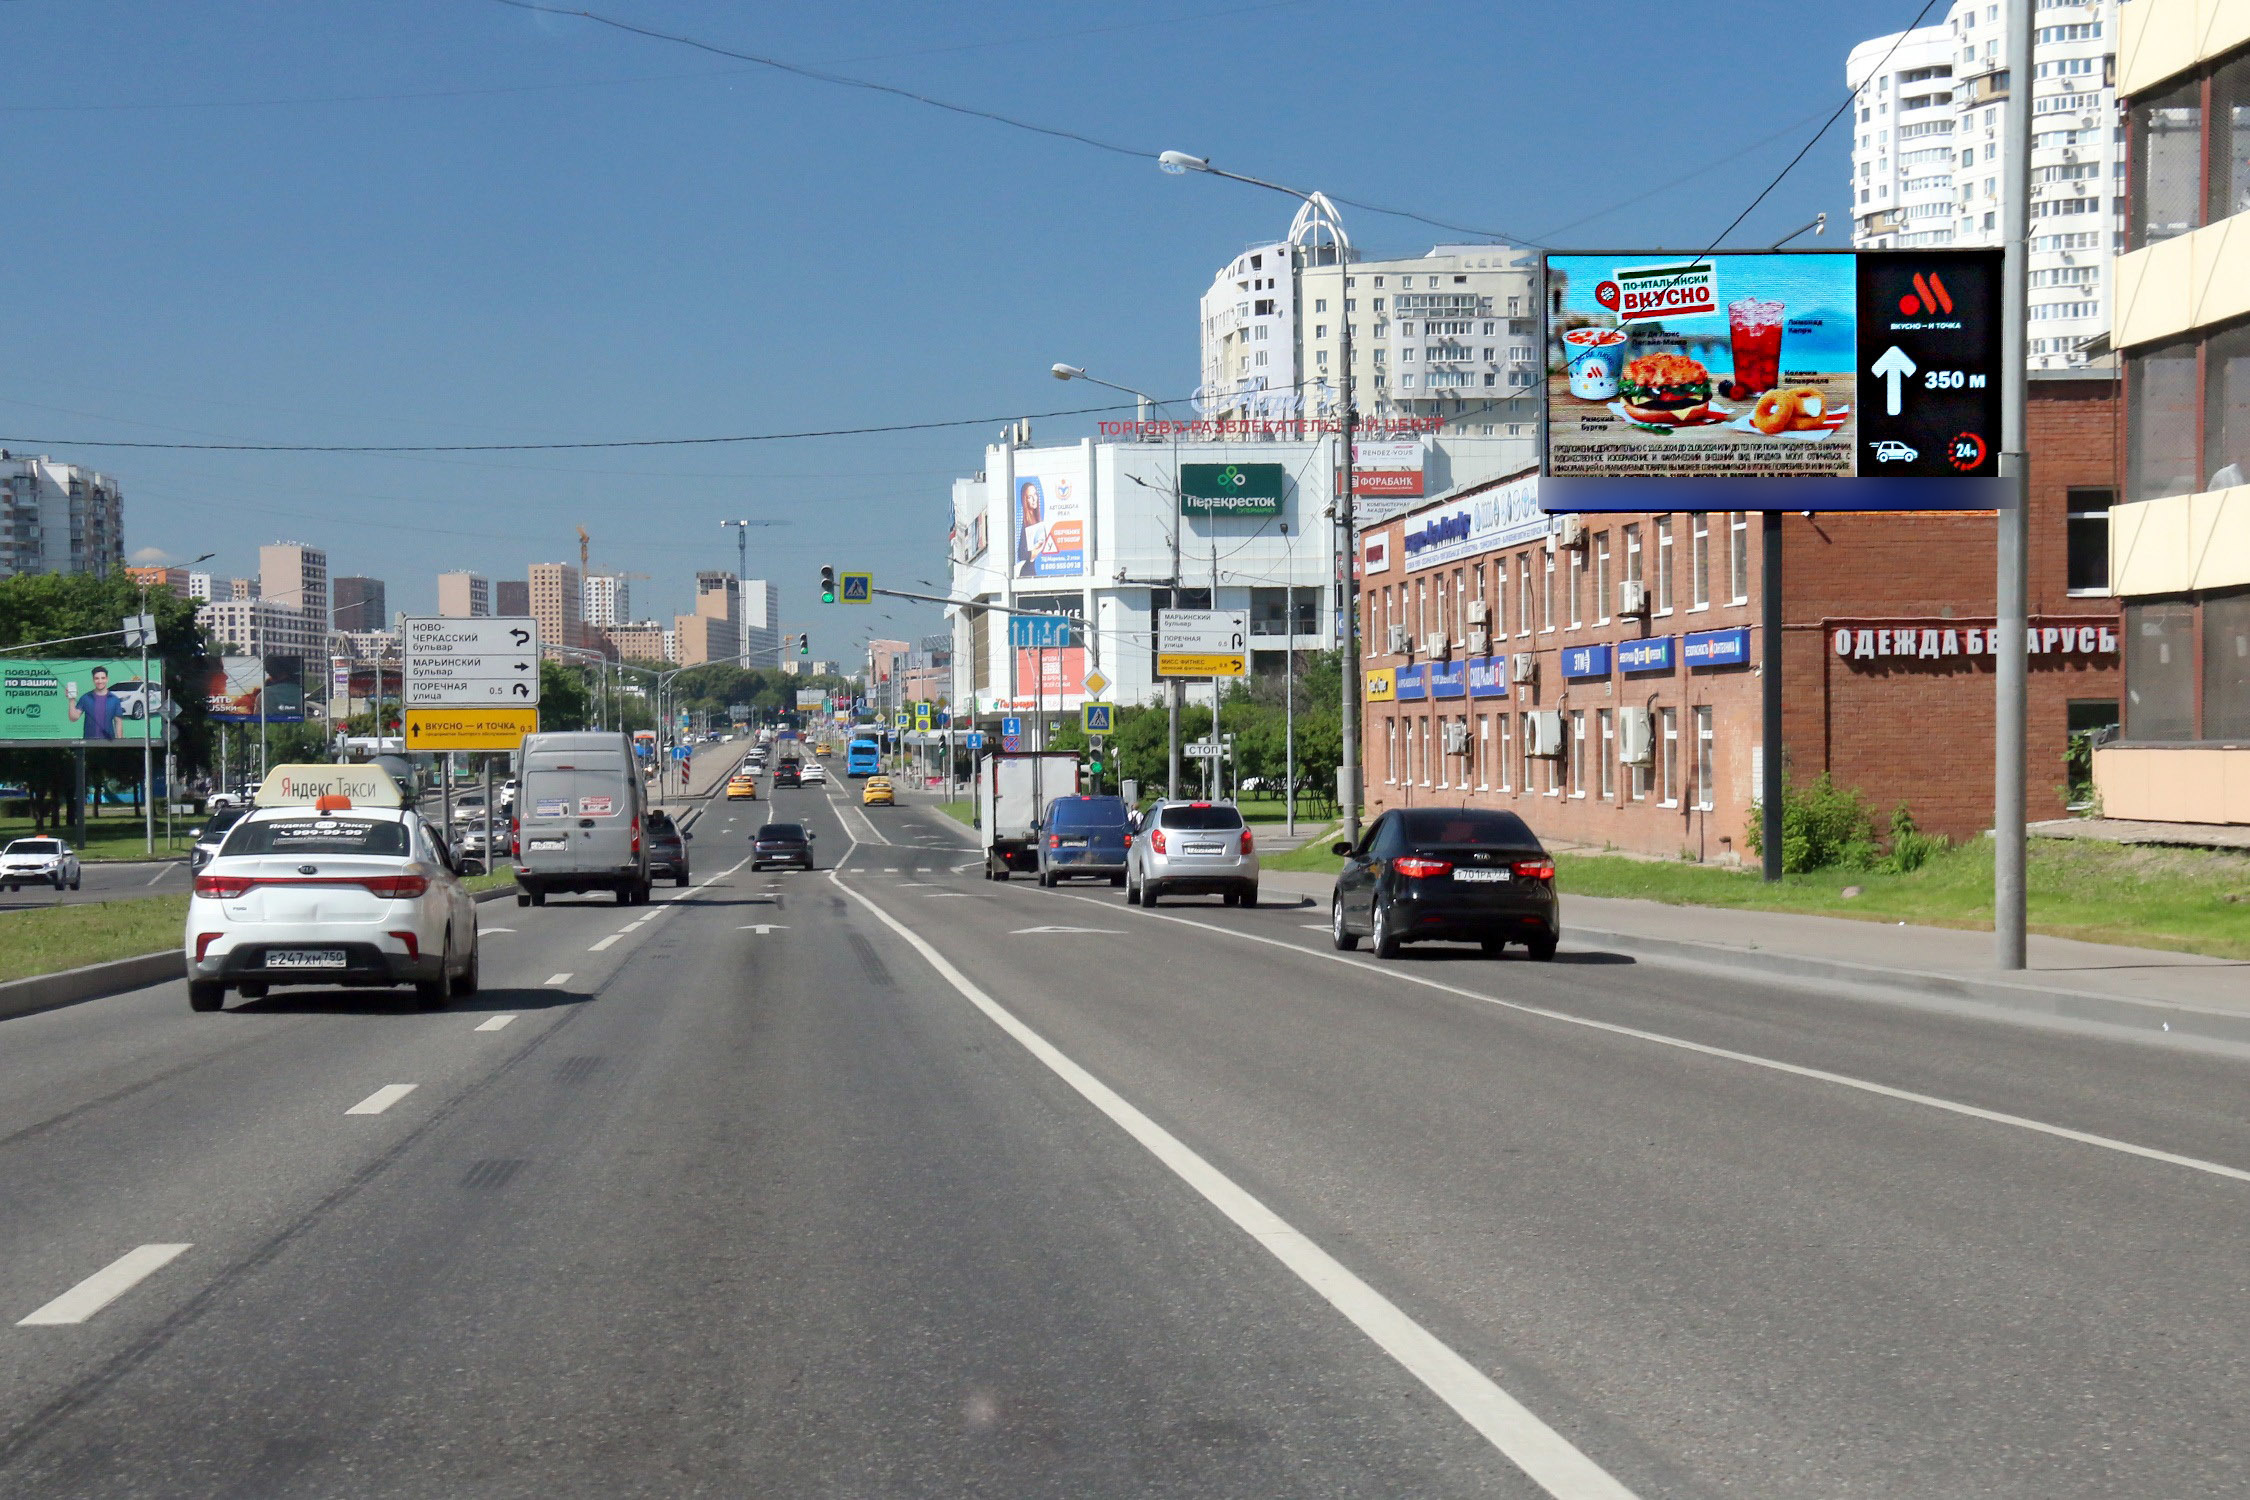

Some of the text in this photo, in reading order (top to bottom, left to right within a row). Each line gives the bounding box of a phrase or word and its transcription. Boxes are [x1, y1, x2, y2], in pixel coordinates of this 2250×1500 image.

[1623, 275, 1708, 290] ПО-ИТАЛЬЯНСКИ
[1624, 286, 1710, 309] ВКУСНО
[1924, 371, 1964, 389] 350
[1385, 417, 1445, 433] ЦЕНТР
[1361, 477, 1413, 486] ФОРАБАНК
[1164, 613, 1211, 621] МАРЬИНСКИЙ
[413, 624, 445, 632] НОВО-
[412, 632, 478, 642] ЧЕРКАССКИЙ
[413, 643, 453, 652] бульвар
[1834, 626, 2116, 660] ОДЕЖДА БЕАРУСЬ
[413, 657, 481, 666] МАРЬИНСКИЙ
[5, 668, 50, 678] поездки
[413, 668, 453, 676] бульвар
[413, 683, 467, 691] ПОРЕЧНАЯ
[489, 687, 503, 695] 0.5
[5, 689, 58, 698] правилам
[413, 693, 442, 701] улица
[425, 722, 463, 730] ВКУСНО
[486, 722, 516, 730] ТОЧКА
[1189, 746, 1218, 754] СТОП
[282, 777, 376, 800] Яндекс Такси
[269, 822, 313, 830] Яндекс
[339, 822, 373, 830] Такси
[324, 952, 343, 961] 750
